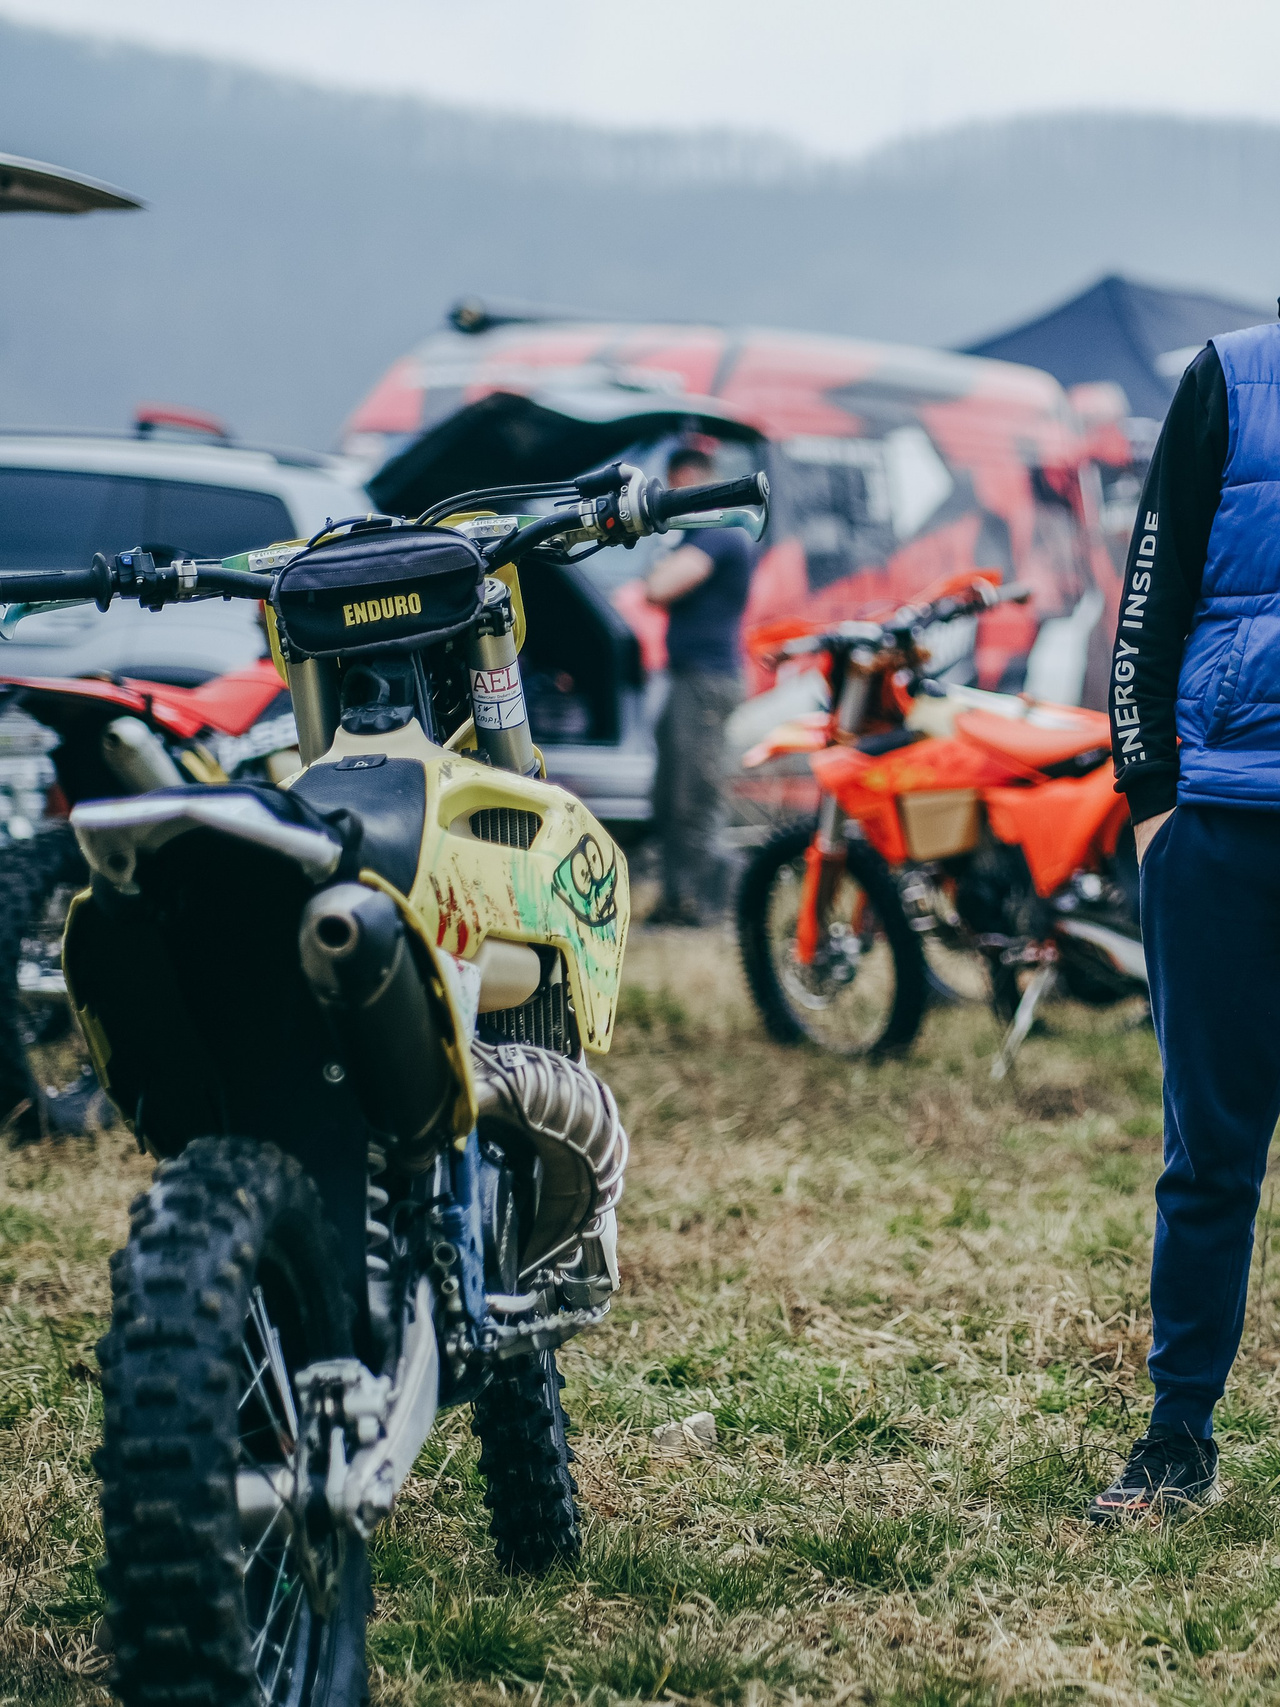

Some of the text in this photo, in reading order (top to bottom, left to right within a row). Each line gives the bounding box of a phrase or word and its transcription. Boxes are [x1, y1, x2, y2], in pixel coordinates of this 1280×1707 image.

[1122, 511, 1159, 629] INSIDE
[342, 592, 422, 627] ENDURO
[473, 668, 519, 694] AEL
